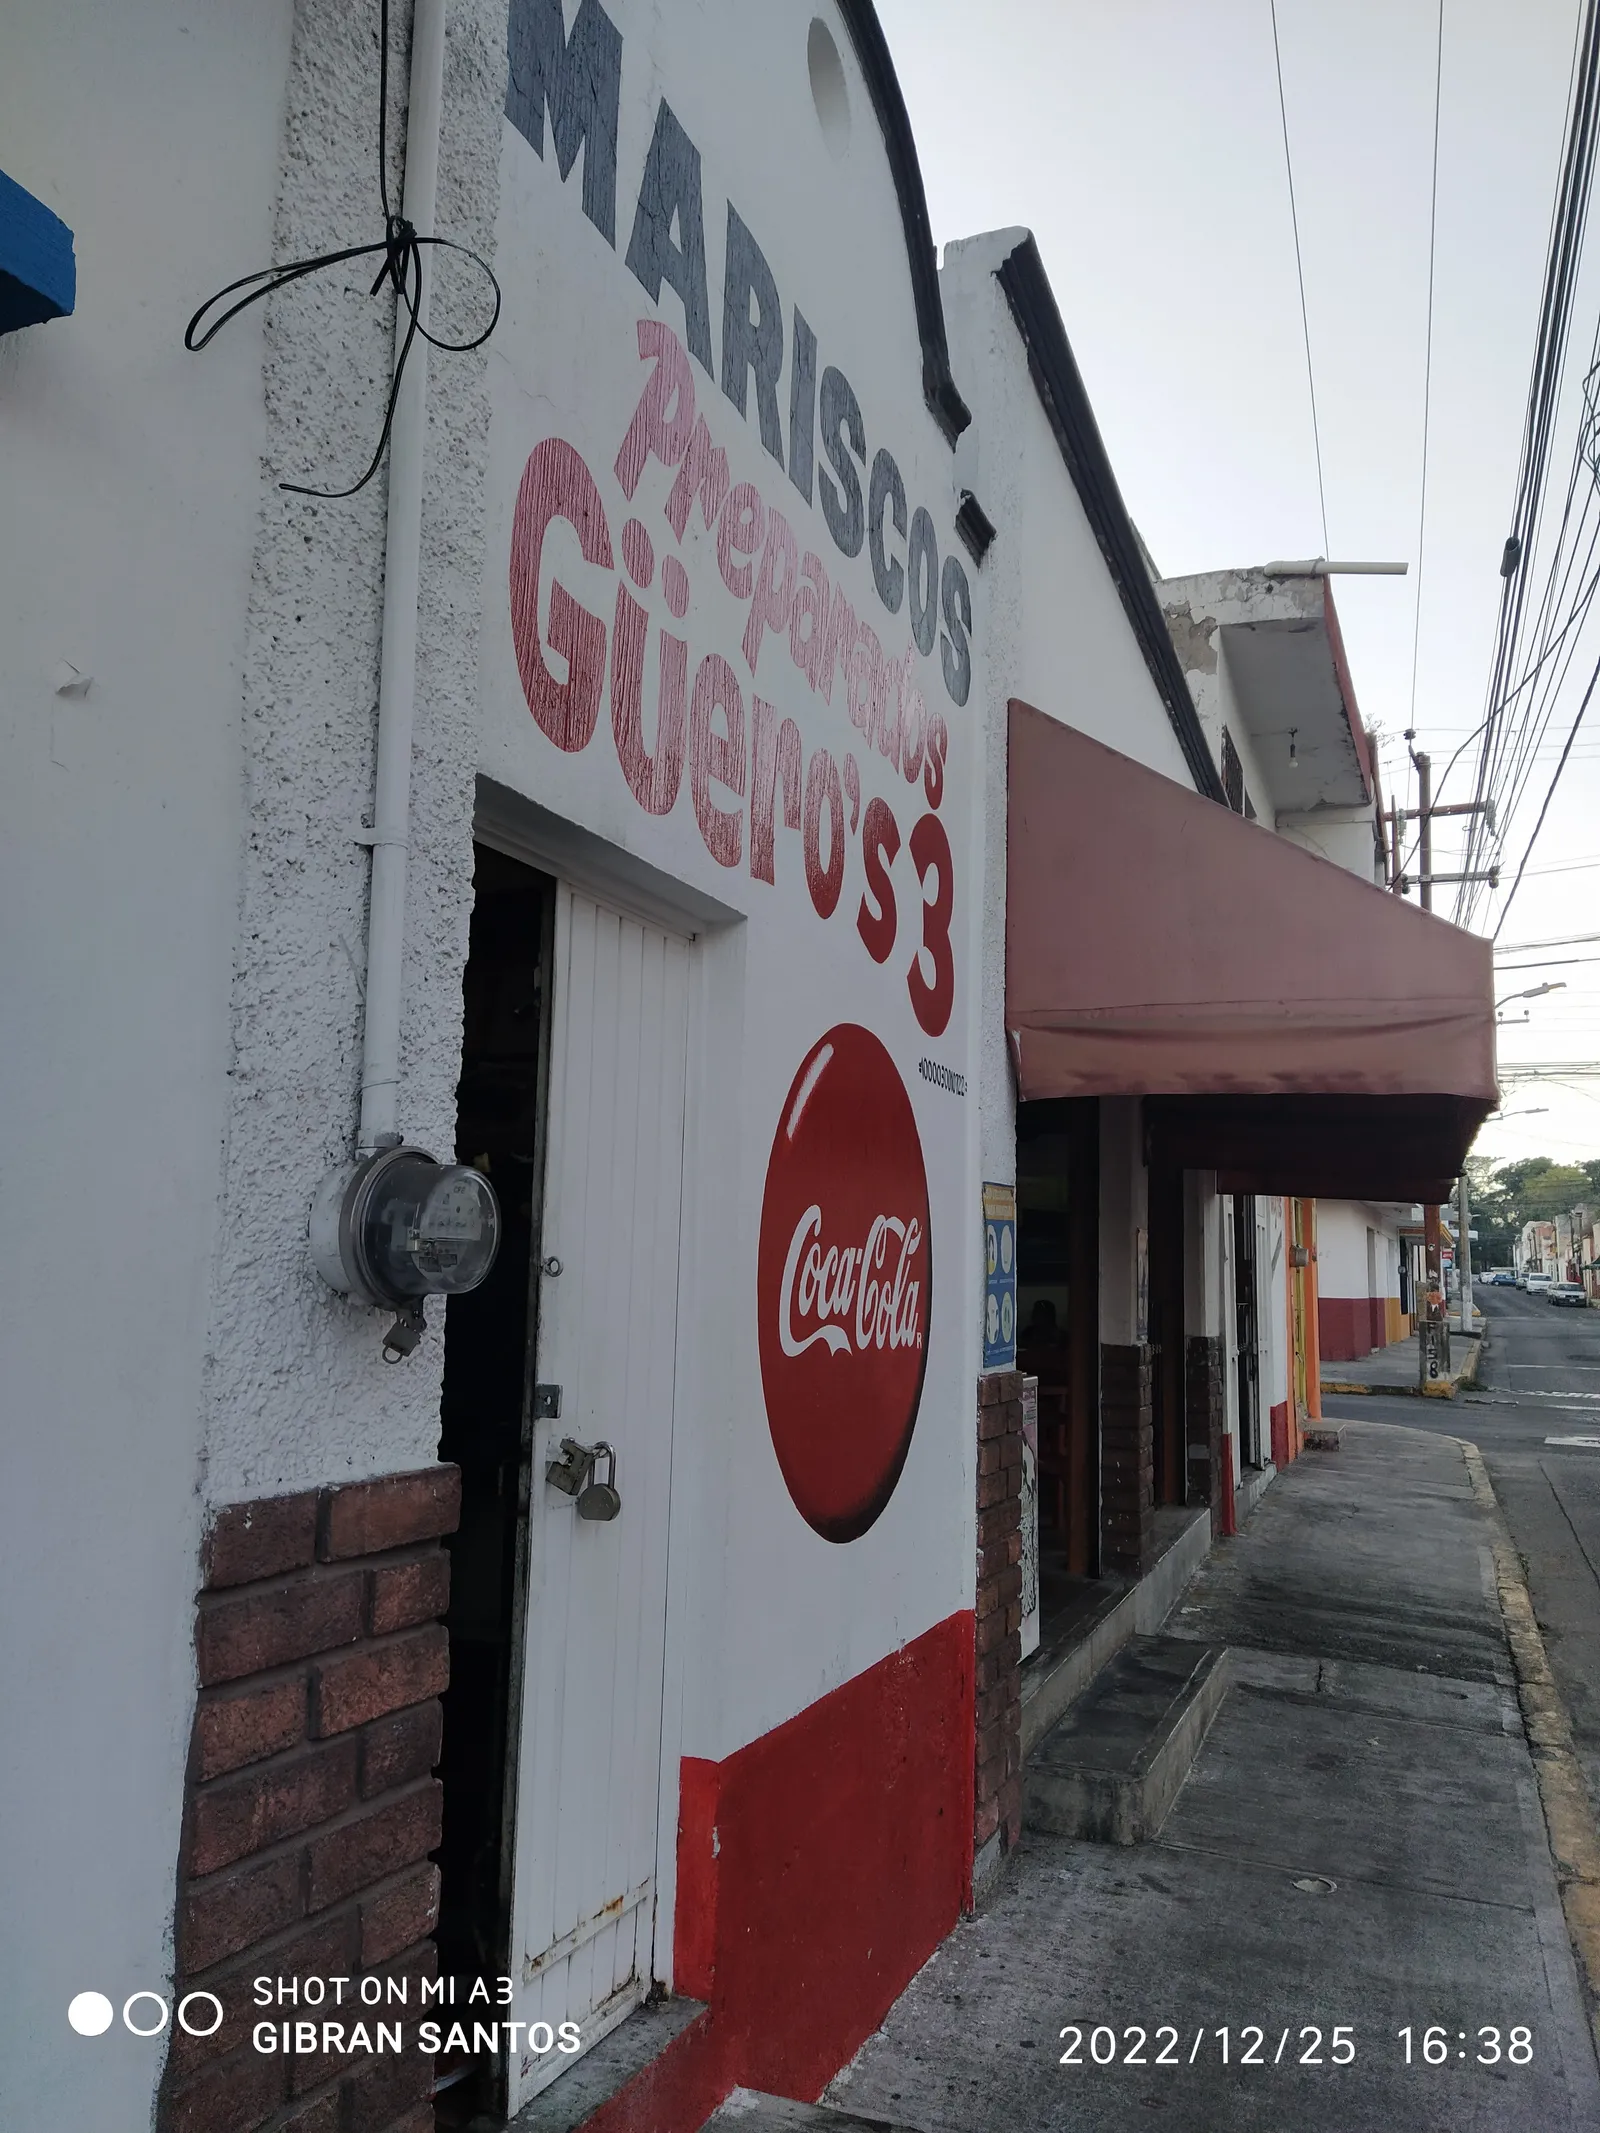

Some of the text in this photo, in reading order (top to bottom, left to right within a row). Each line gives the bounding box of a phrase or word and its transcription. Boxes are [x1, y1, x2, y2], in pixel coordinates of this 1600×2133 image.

[503, 0, 972, 707] MARISCOS
[509, 437, 954, 1037] Güero's 3
[779, 1204, 922, 1358] Coca-Cola
